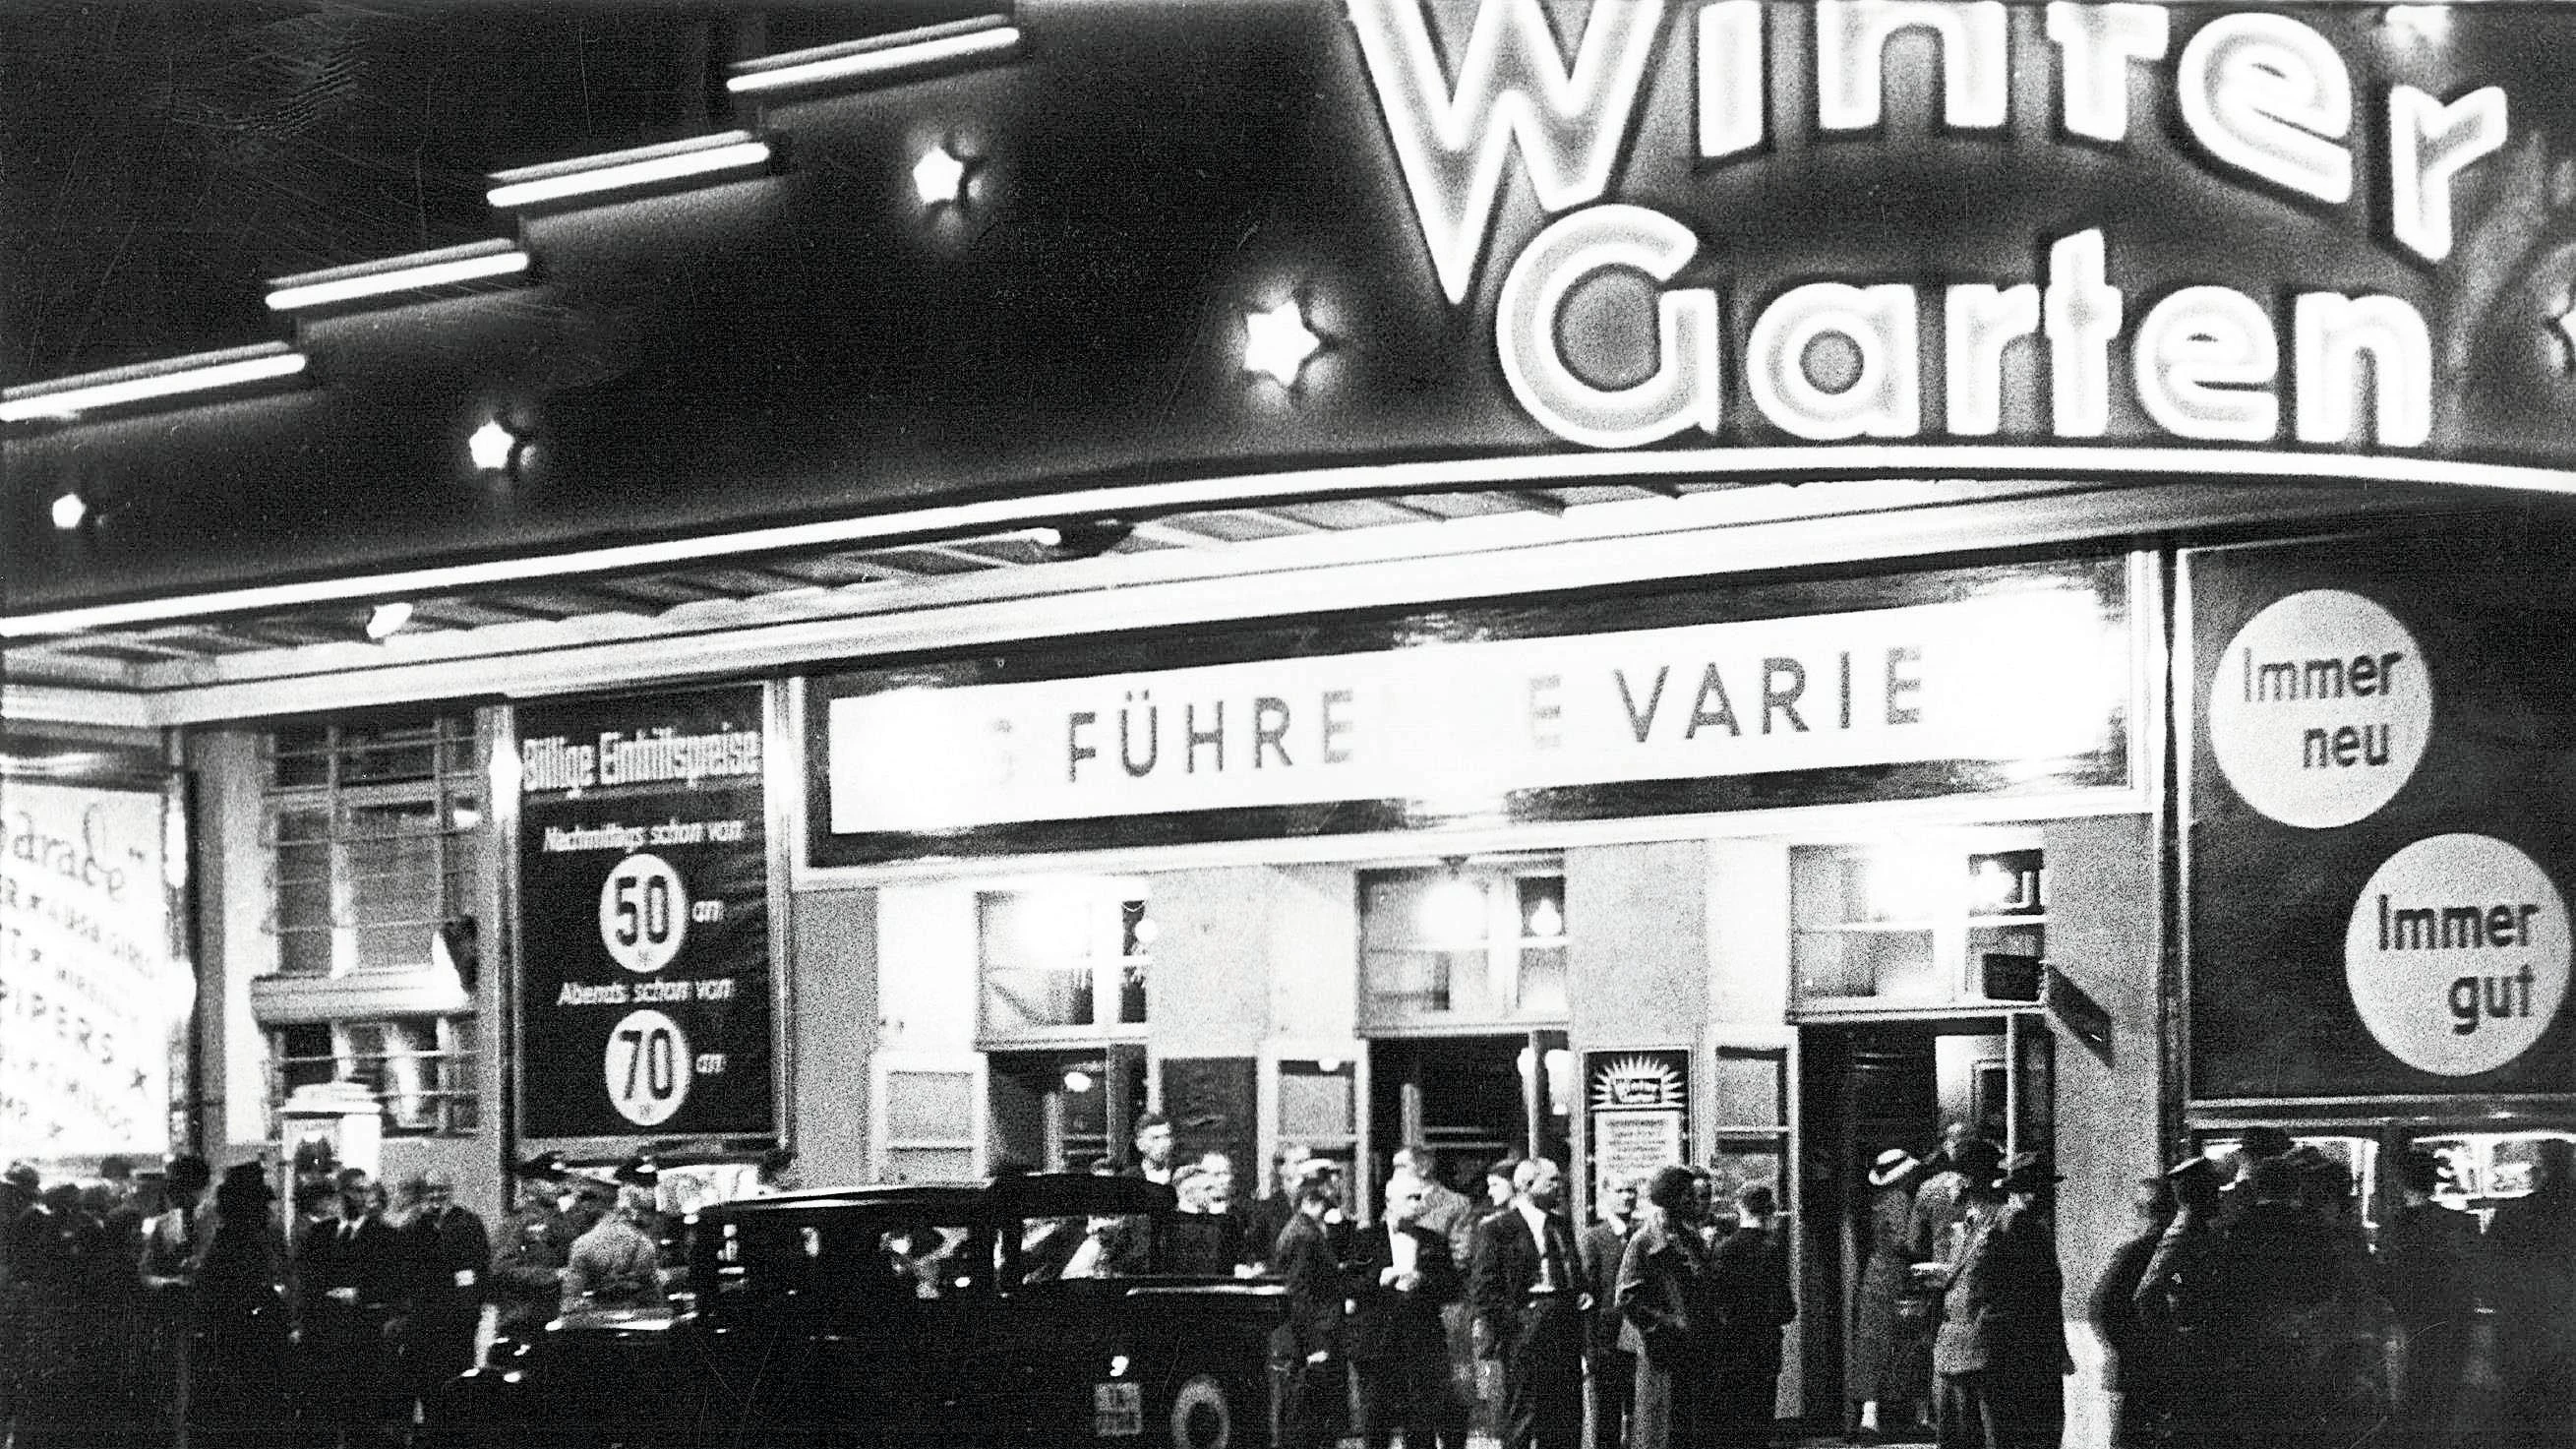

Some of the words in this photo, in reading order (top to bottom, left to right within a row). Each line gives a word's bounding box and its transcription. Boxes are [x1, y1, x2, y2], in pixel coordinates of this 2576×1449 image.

[1345, 0, 2507, 304] Winter
[1495, 204, 2435, 450] Garten
[2243, 646, 2403, 702] Immer
[2303, 722, 2389, 769] neu
[616, 875, 670, 946] 50
[2378, 893, 2540, 950] Immer
[2448, 963, 2535, 1036] gut
[619, 1028, 675, 1101] 70
